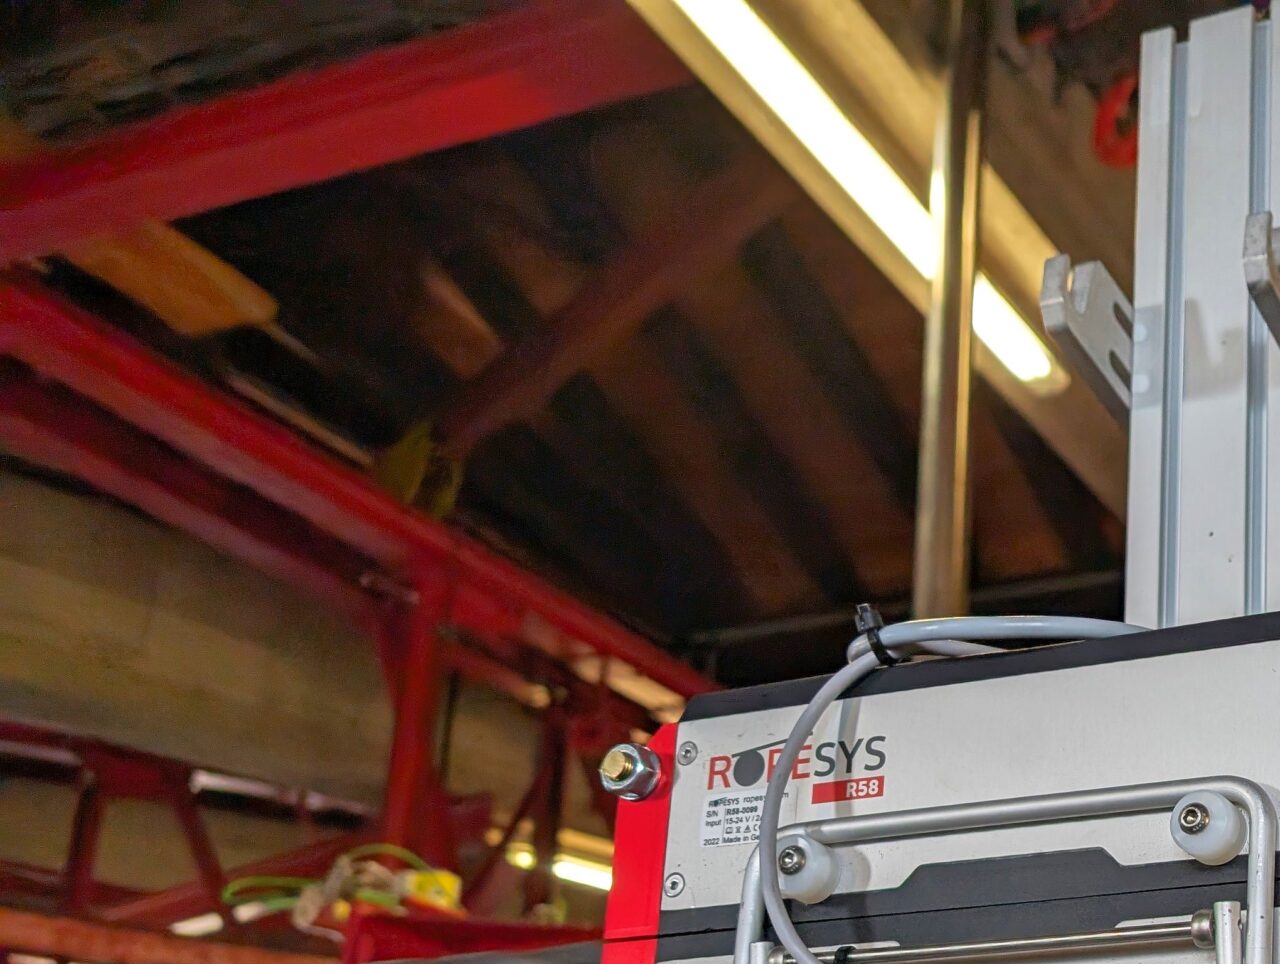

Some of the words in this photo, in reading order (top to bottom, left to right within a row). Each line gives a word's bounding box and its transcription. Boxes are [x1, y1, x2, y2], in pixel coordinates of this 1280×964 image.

[846, 779, 879, 798] R58
[706, 810, 719, 818] S/N
[705, 819, 721, 828] Input
[725, 816, 743, 825] 15-24
[703, 837, 720, 846] 2022
[722, 835, 741, 844] Made
